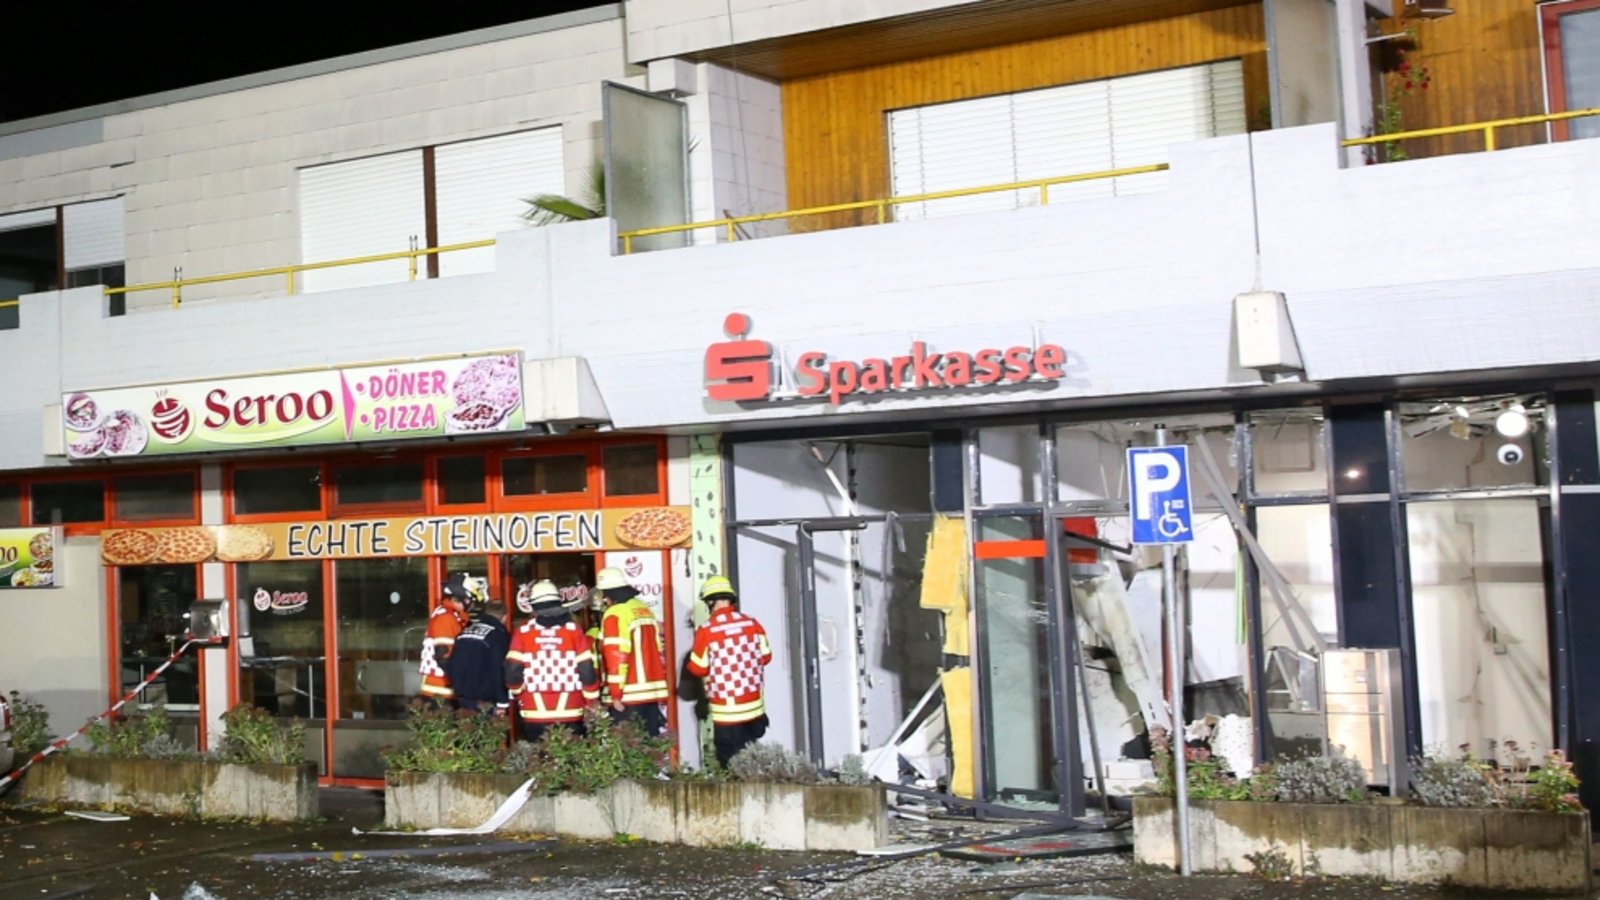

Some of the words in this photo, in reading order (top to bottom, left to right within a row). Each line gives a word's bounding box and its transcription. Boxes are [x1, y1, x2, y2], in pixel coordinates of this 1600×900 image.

[368, 369, 447, 399] DÖNER
[798, 341, 1065, 405] Sparkasse
[203, 388, 334, 428] Seroo
[373, 403, 437, 432] PIZZA
[1133, 452, 1181, 520] P
[288, 521, 388, 556] ECHTE
[405, 513, 601, 552] STEINOFEN
